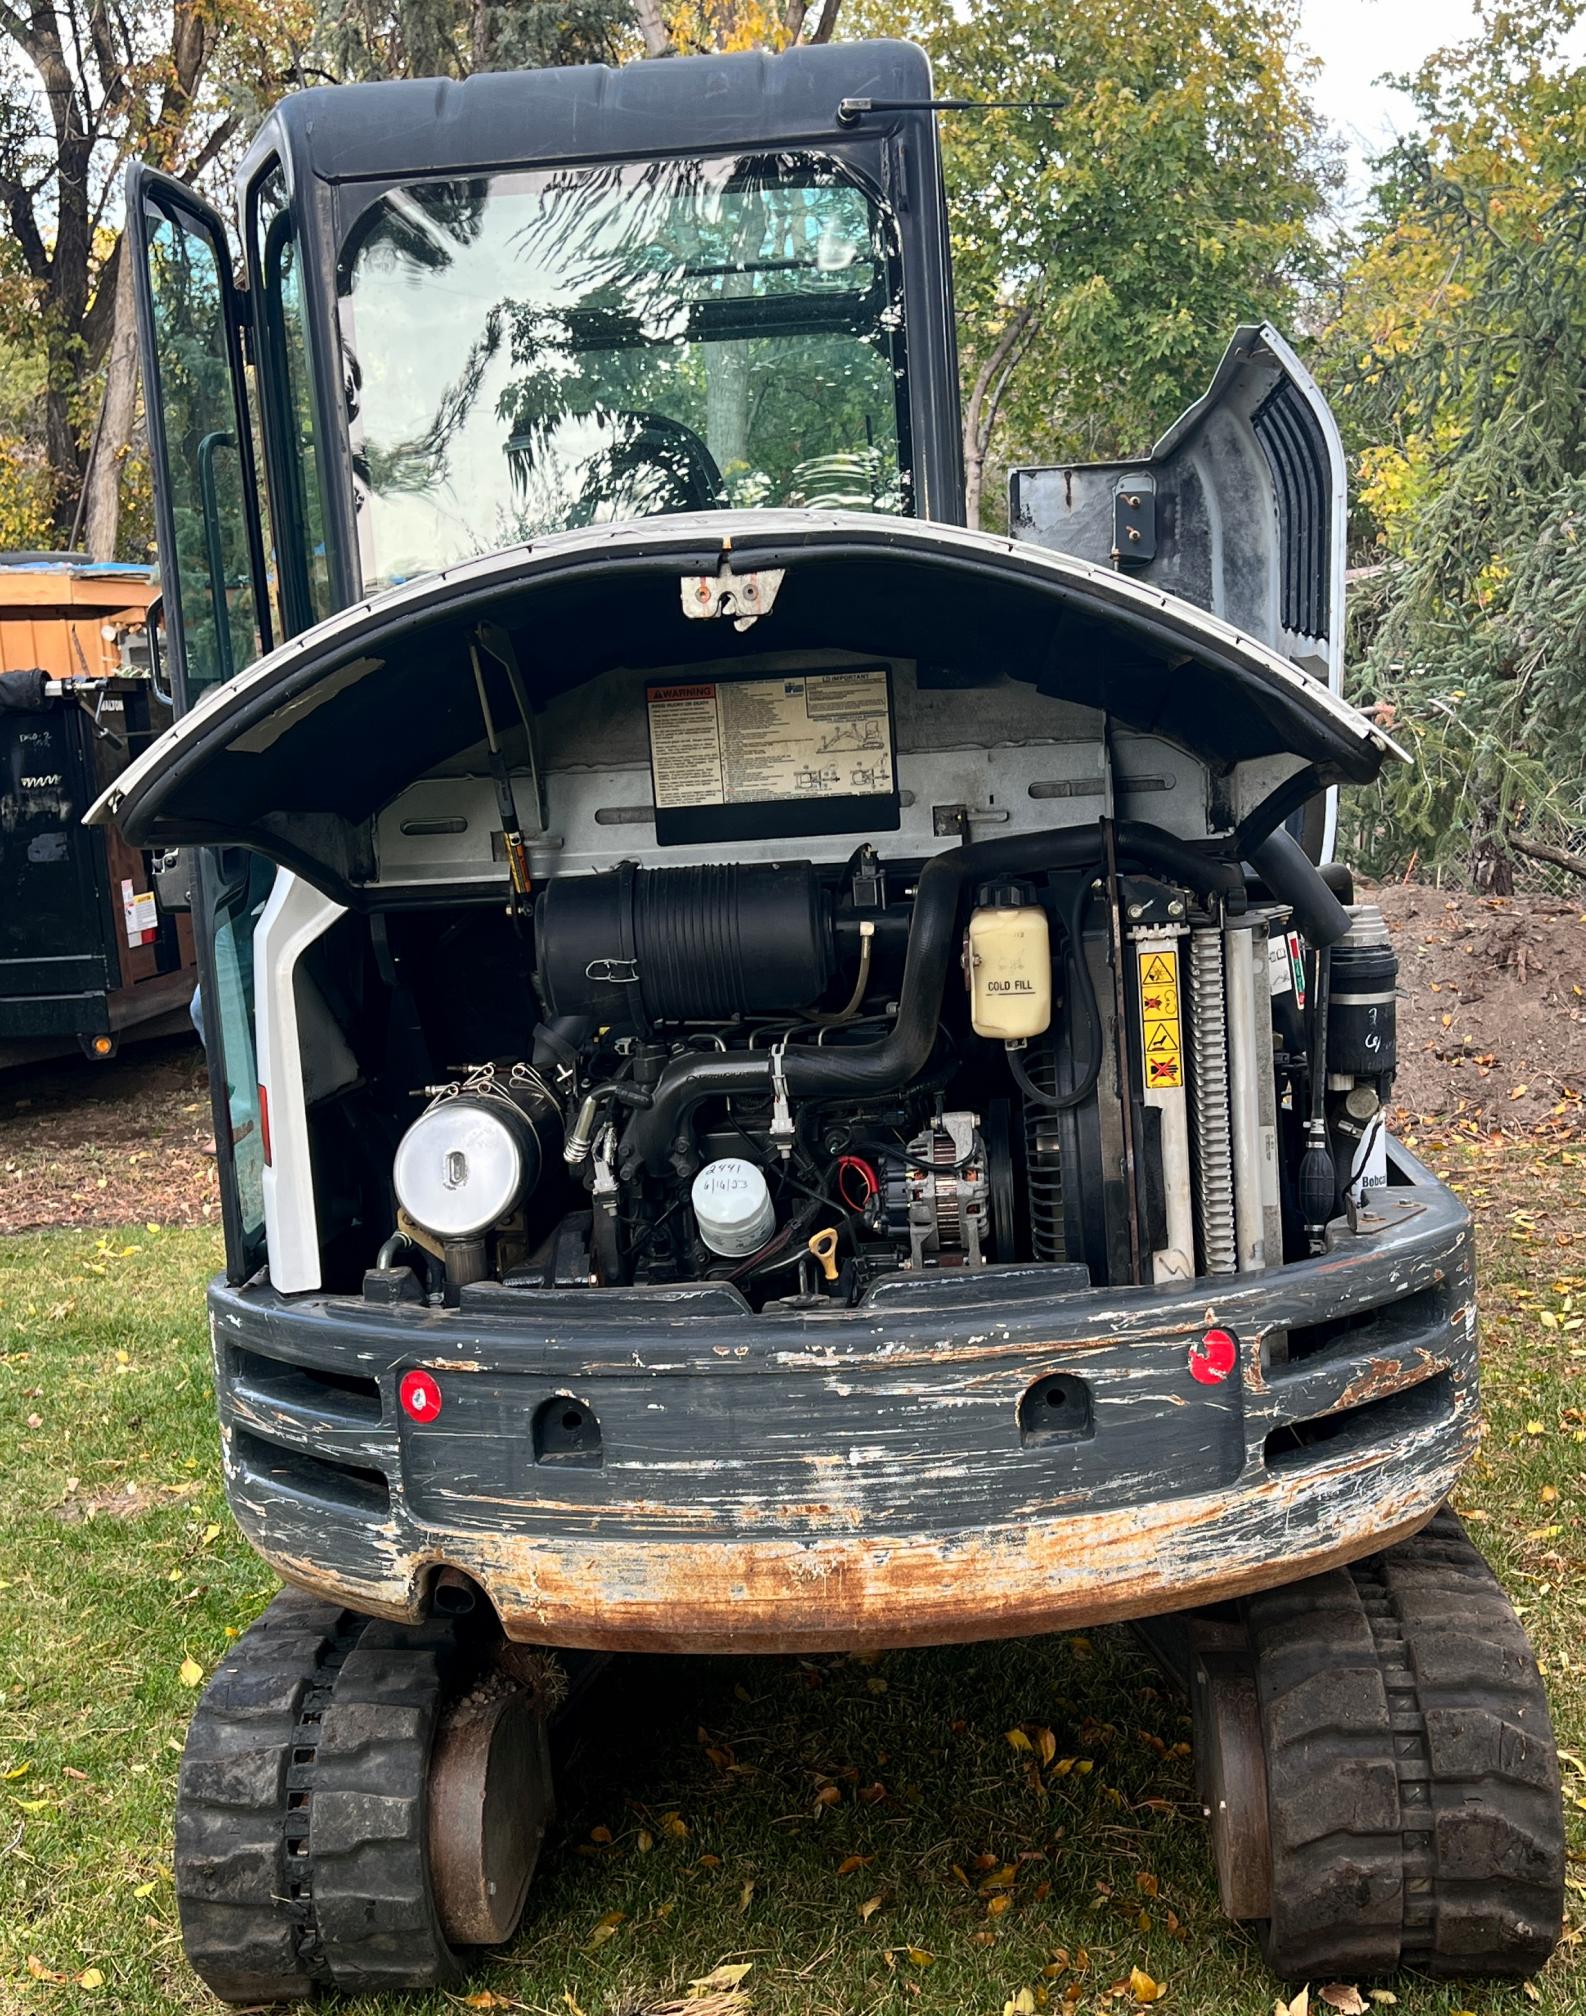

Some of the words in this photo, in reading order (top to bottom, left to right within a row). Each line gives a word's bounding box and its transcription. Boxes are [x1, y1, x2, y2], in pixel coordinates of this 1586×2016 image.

[663, 687, 711, 698] WARNING
[988, 981, 1010, 991] COLD
[1014, 980, 1032, 990] FILL
[706, 1164, 741, 1175] 2441
